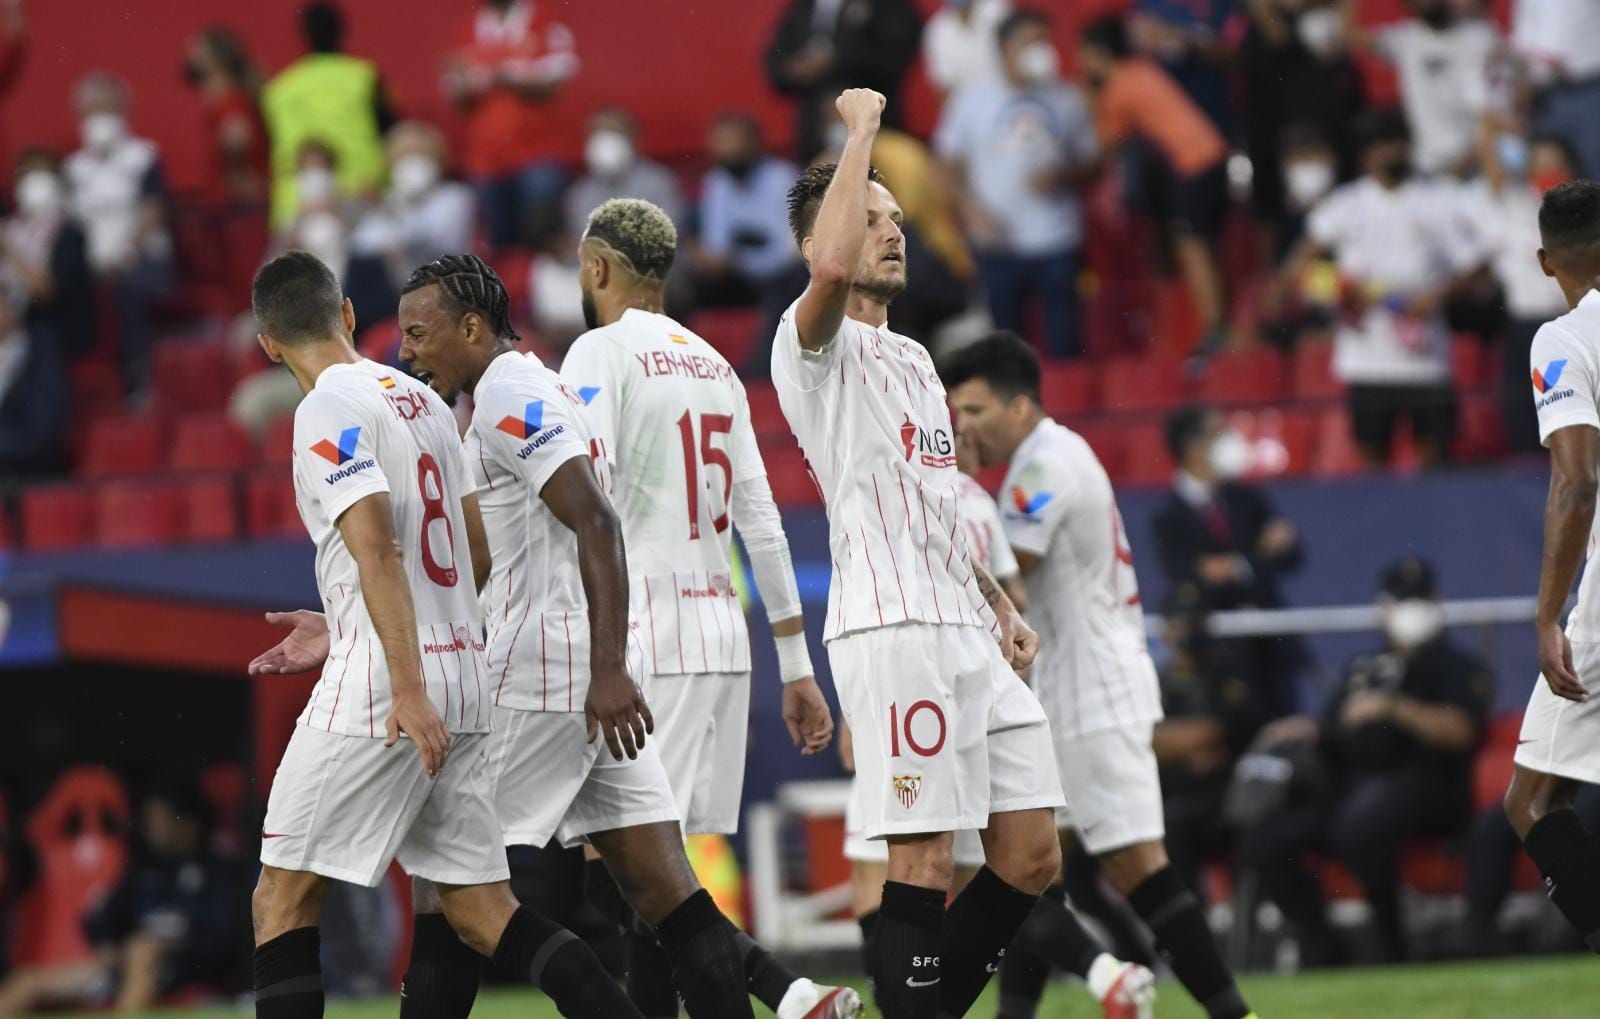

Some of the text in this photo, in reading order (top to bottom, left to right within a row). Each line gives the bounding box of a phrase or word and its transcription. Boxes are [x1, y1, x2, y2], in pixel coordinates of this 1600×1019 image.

[1535, 388, 1575, 411] alvoline
[516, 424, 565, 460] Valvoline
[324, 458, 376, 486] Valvoline
[676, 407, 734, 541] 15
[416, 452, 459, 588] 8
[423, 642, 456, 654] Manos
[889, 700, 947, 757] 10
